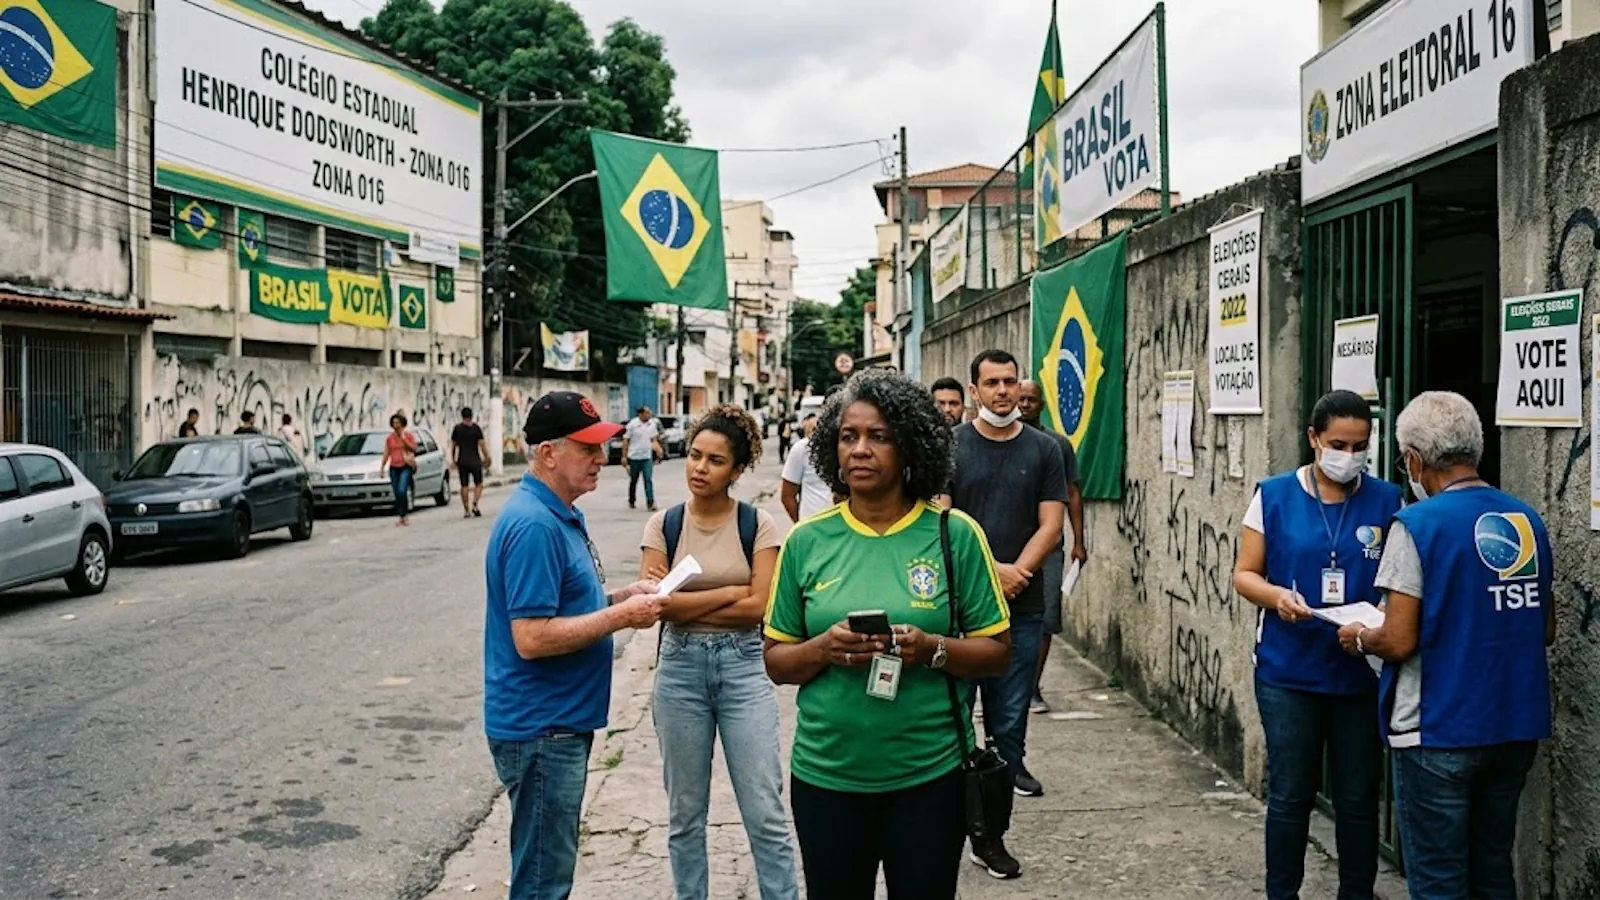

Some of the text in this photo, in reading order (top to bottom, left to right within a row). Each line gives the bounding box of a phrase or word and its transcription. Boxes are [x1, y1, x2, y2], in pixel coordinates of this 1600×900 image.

[1336, 0, 1516, 140] ZONA ELEITORAL 16
[261, 47, 418, 135] COLÉGIO ESTADUAL
[182, 66, 285, 133] HENRIQUE
[292, 105, 395, 167] DODSWORTH
[410, 147, 444, 184] ZONA
[449, 160, 470, 192] 016
[1063, 79, 1131, 183] BRASIL
[312, 159, 385, 205] ZONA 016
[1103, 133, 1150, 197] VOTA
[1213, 230, 1257, 264] ELEIÇÕES
[258, 272, 386, 318] BRASIL VOTA
[1220, 293, 1247, 321] 2022
[1215, 342, 1254, 365] LOCAL DE
[1515, 338, 1567, 369] VOTE
[1215, 367, 1254, 395] VOTAÇÃO
[1515, 378, 1564, 409] AQUI
[1487, 582, 1541, 611] TSE
